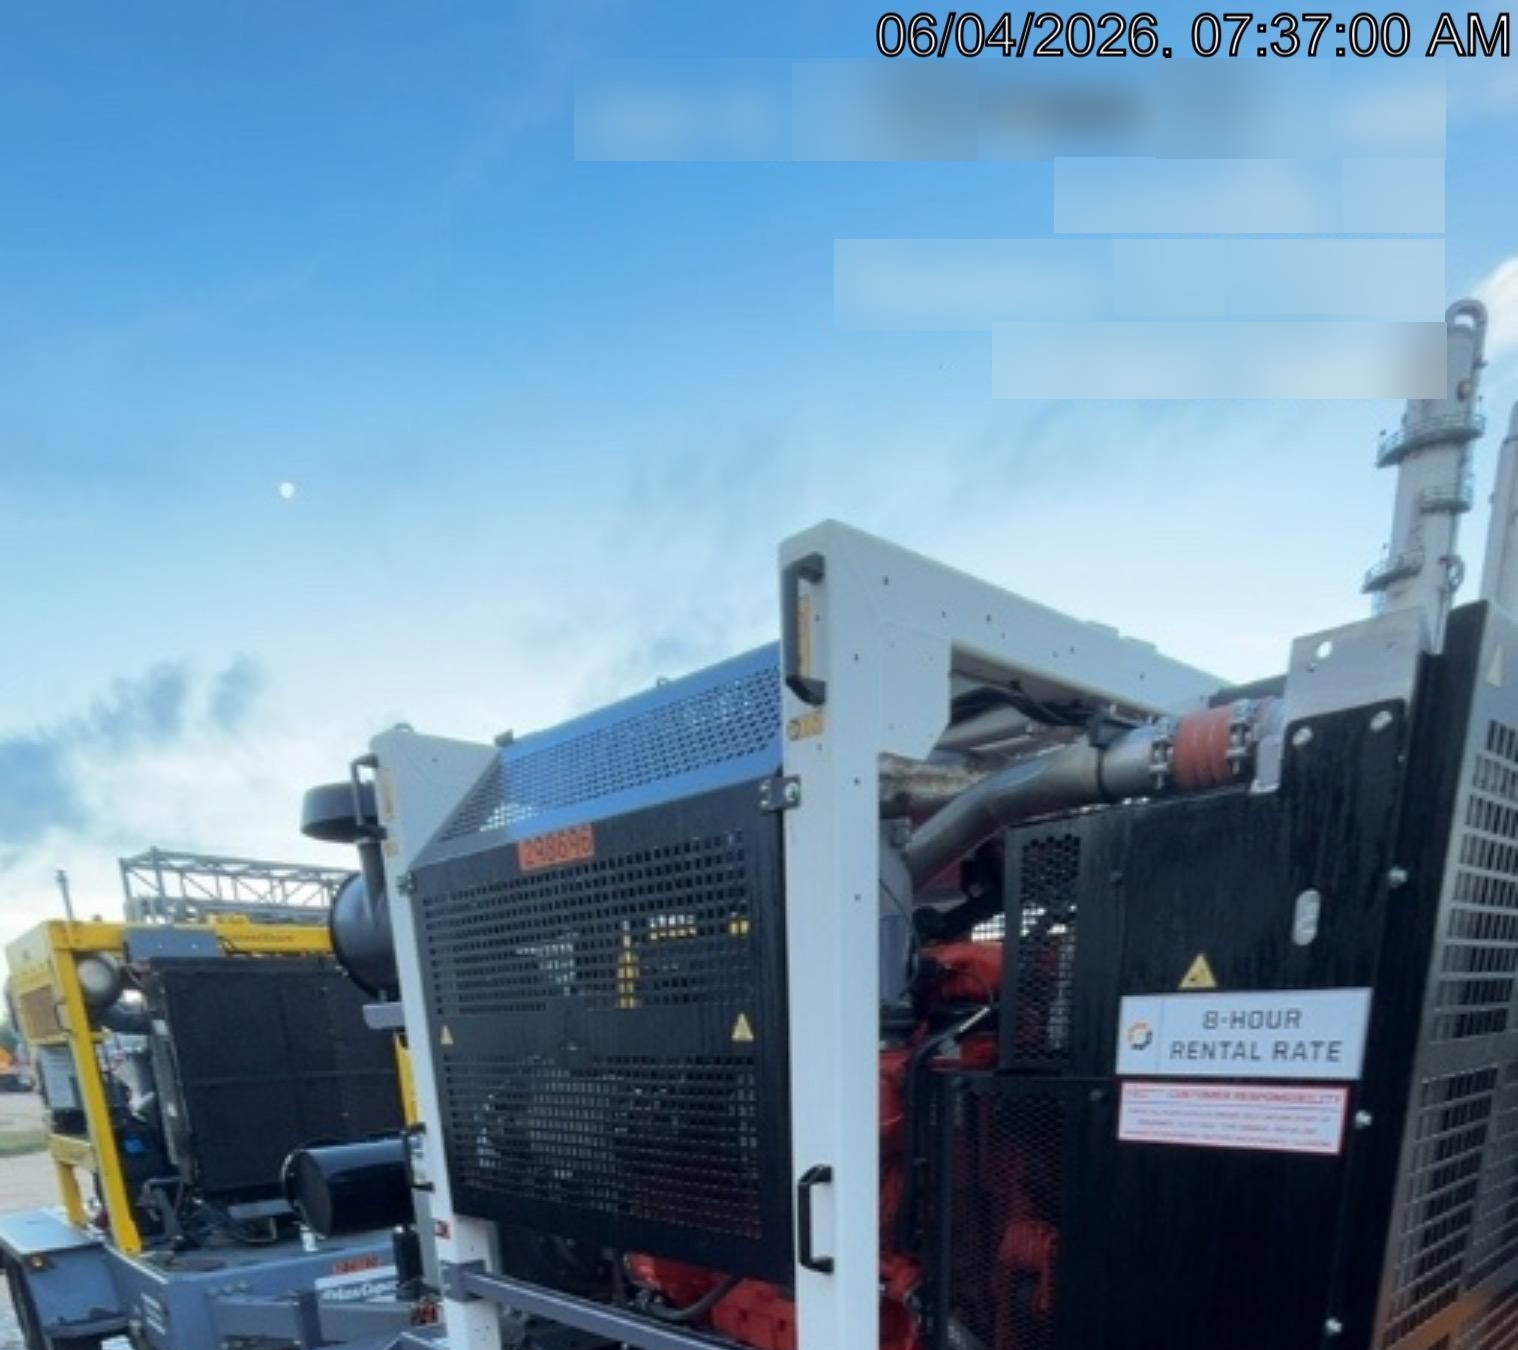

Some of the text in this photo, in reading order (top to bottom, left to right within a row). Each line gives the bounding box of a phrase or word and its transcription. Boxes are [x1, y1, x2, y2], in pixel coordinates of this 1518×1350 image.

[1203, 1008, 1303, 1030] 8-HOUR
[1169, 1041, 1343, 1062] RENTAL RATE
